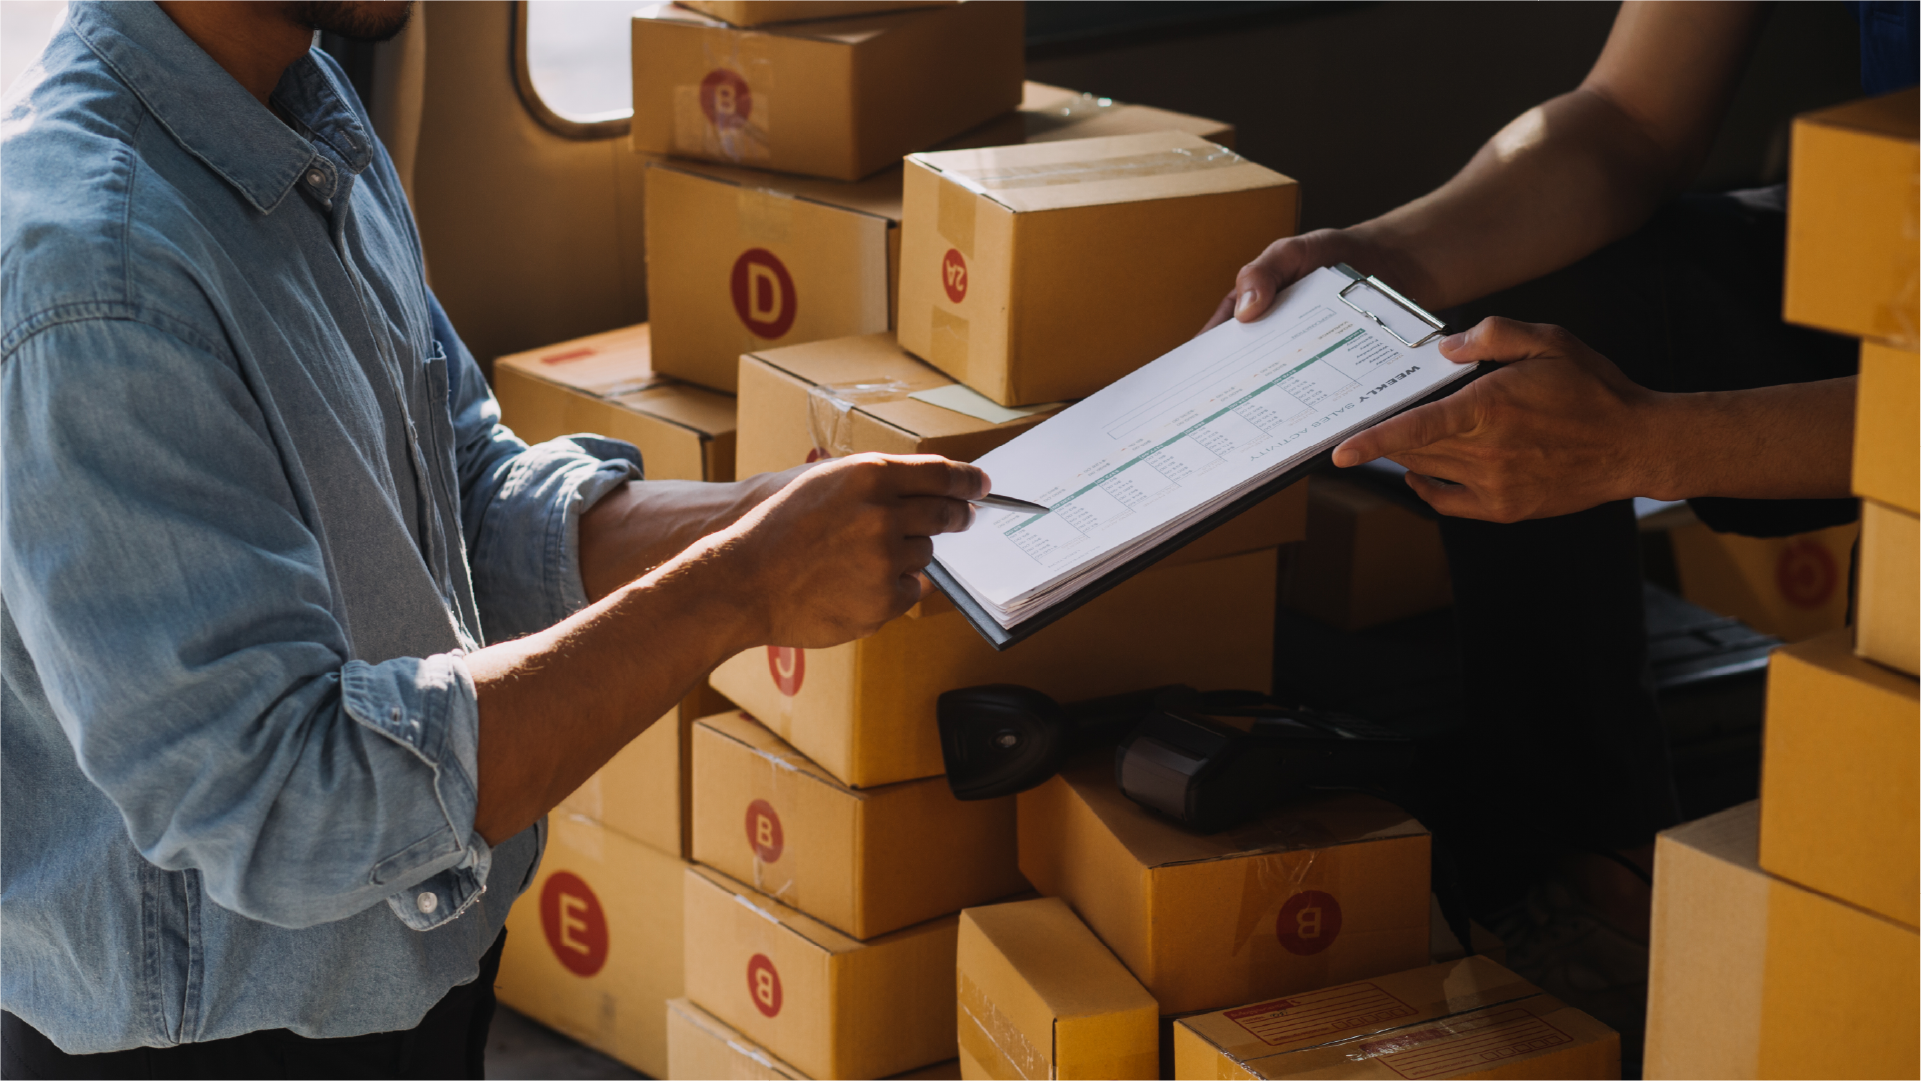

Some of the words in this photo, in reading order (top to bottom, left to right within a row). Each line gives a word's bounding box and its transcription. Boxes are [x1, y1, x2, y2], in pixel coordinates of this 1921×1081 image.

[715, 86, 736, 114] B
[945, 259, 965, 293] 2A
[748, 262, 783, 325] D
[1345, 335, 1374, 352] Saturday
[1353, 344, 1389, 365] Wednesday
[1354, 341, 1384, 358] Thursday
[1358, 338, 1379, 350] Friday
[1367, 347, 1394, 363] Tuesday
[1374, 351, 1399, 365] Monday
[1353, 364, 1422, 404] WEEKLY
[1308, 401, 1356, 429] SALES
[1246, 426, 1310, 462] ACTIVITY
[756, 814, 773, 850] B
[558, 892, 590, 956] E
[1296, 907, 1321, 939] B
[756, 967, 773, 1008] B
